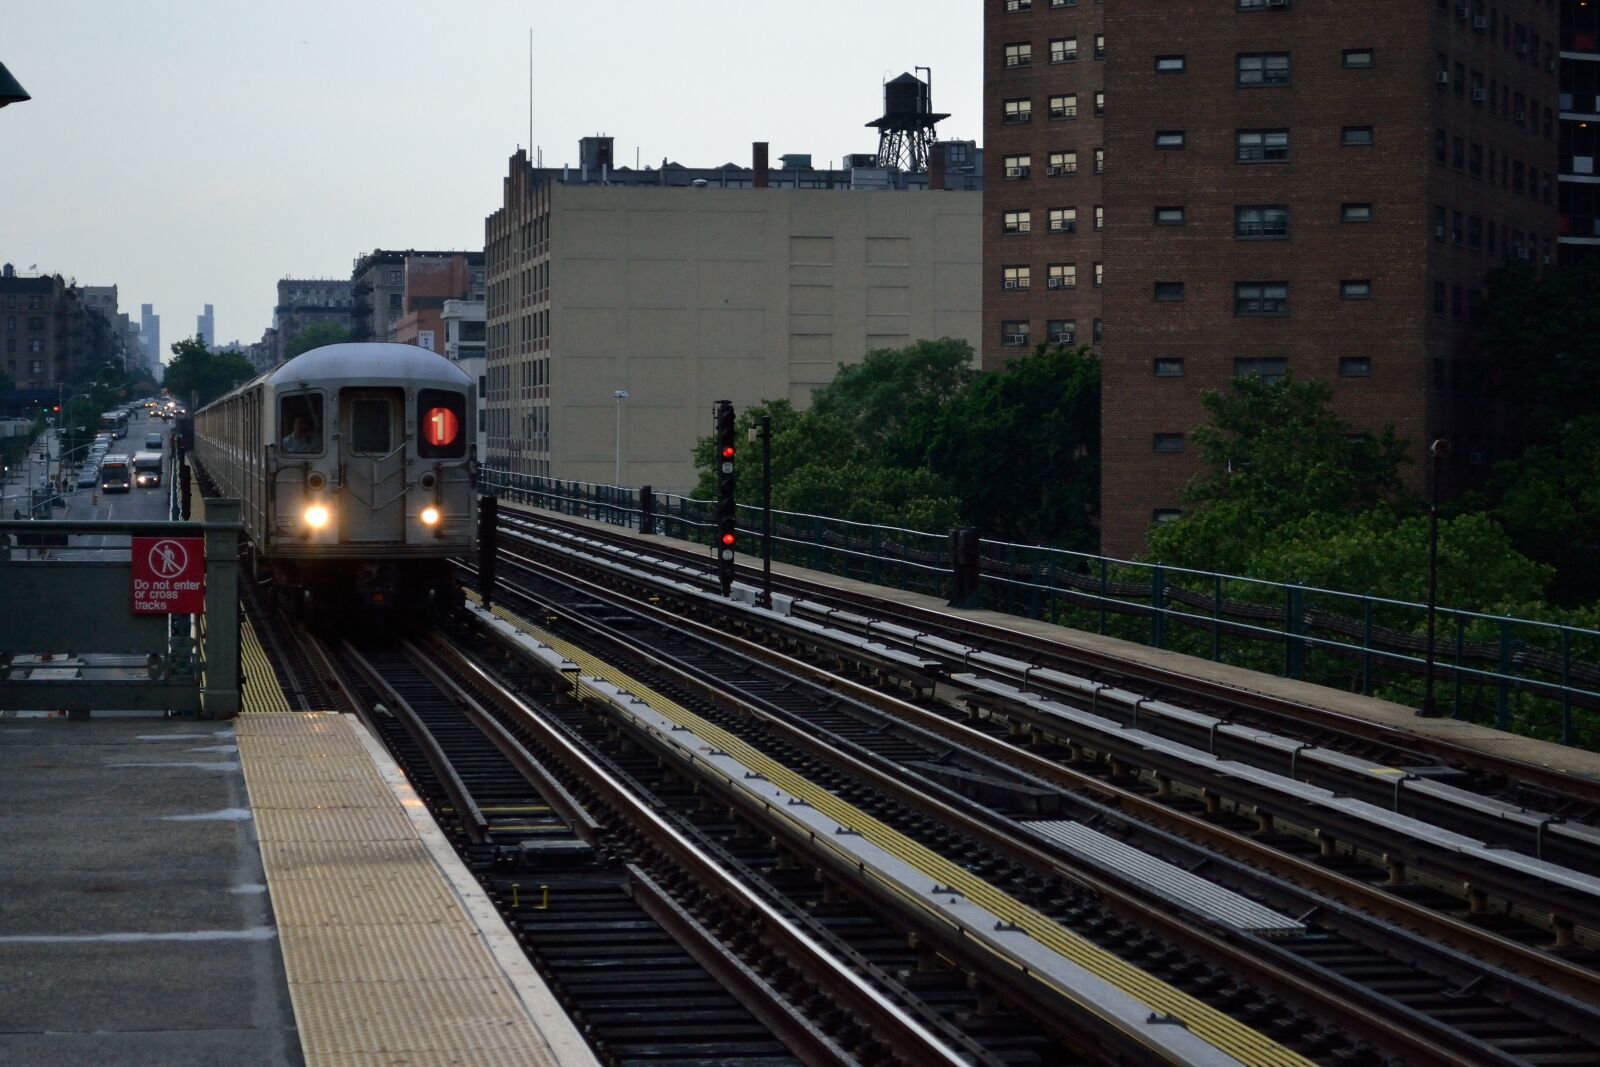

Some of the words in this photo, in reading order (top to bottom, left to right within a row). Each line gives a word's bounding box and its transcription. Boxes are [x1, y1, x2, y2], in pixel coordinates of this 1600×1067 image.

[432, 412, 443, 440] 1
[134, 579, 149, 590] Do
[153, 580, 170, 590] not
[173, 580, 201, 590] enter
[134, 590, 145, 599] or
[149, 590, 178, 599] cross
[135, 599, 167, 610] tracks
